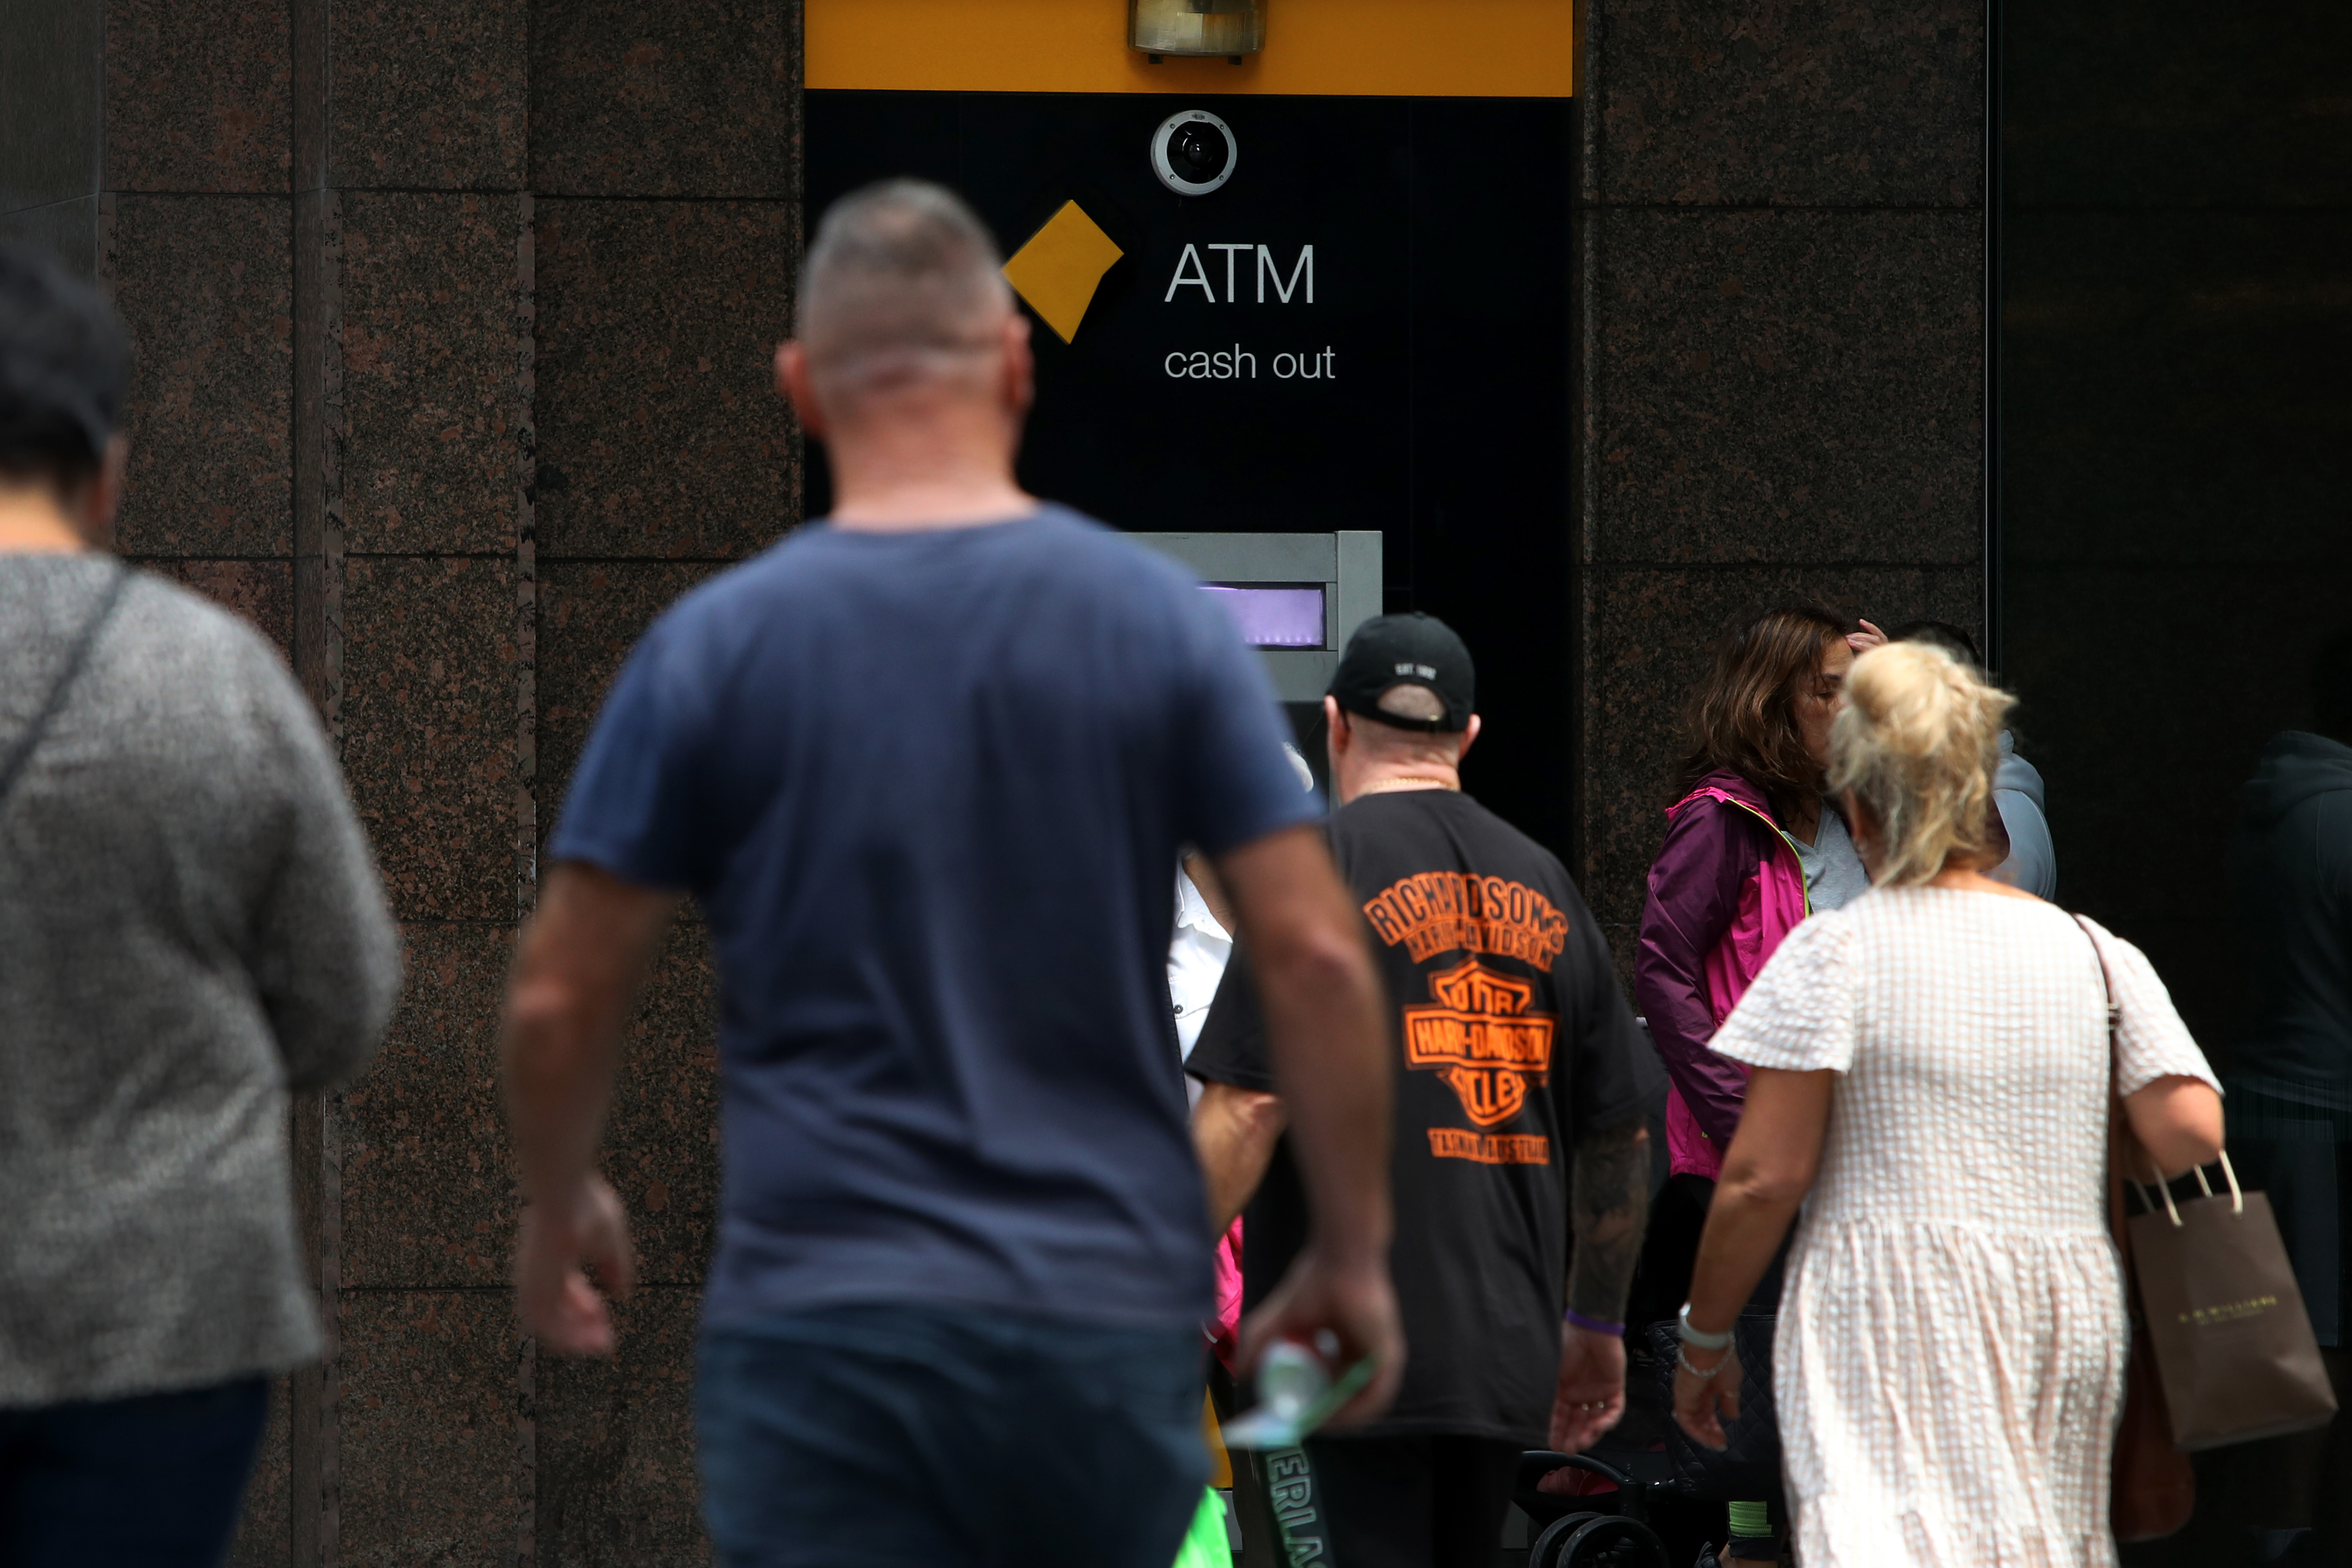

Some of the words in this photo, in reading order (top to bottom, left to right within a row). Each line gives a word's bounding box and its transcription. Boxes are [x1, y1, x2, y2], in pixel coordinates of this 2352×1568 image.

[1164, 243, 1314, 303] ATM
[1164, 343, 1256, 379] cash
[1273, 346, 1336, 379] out
